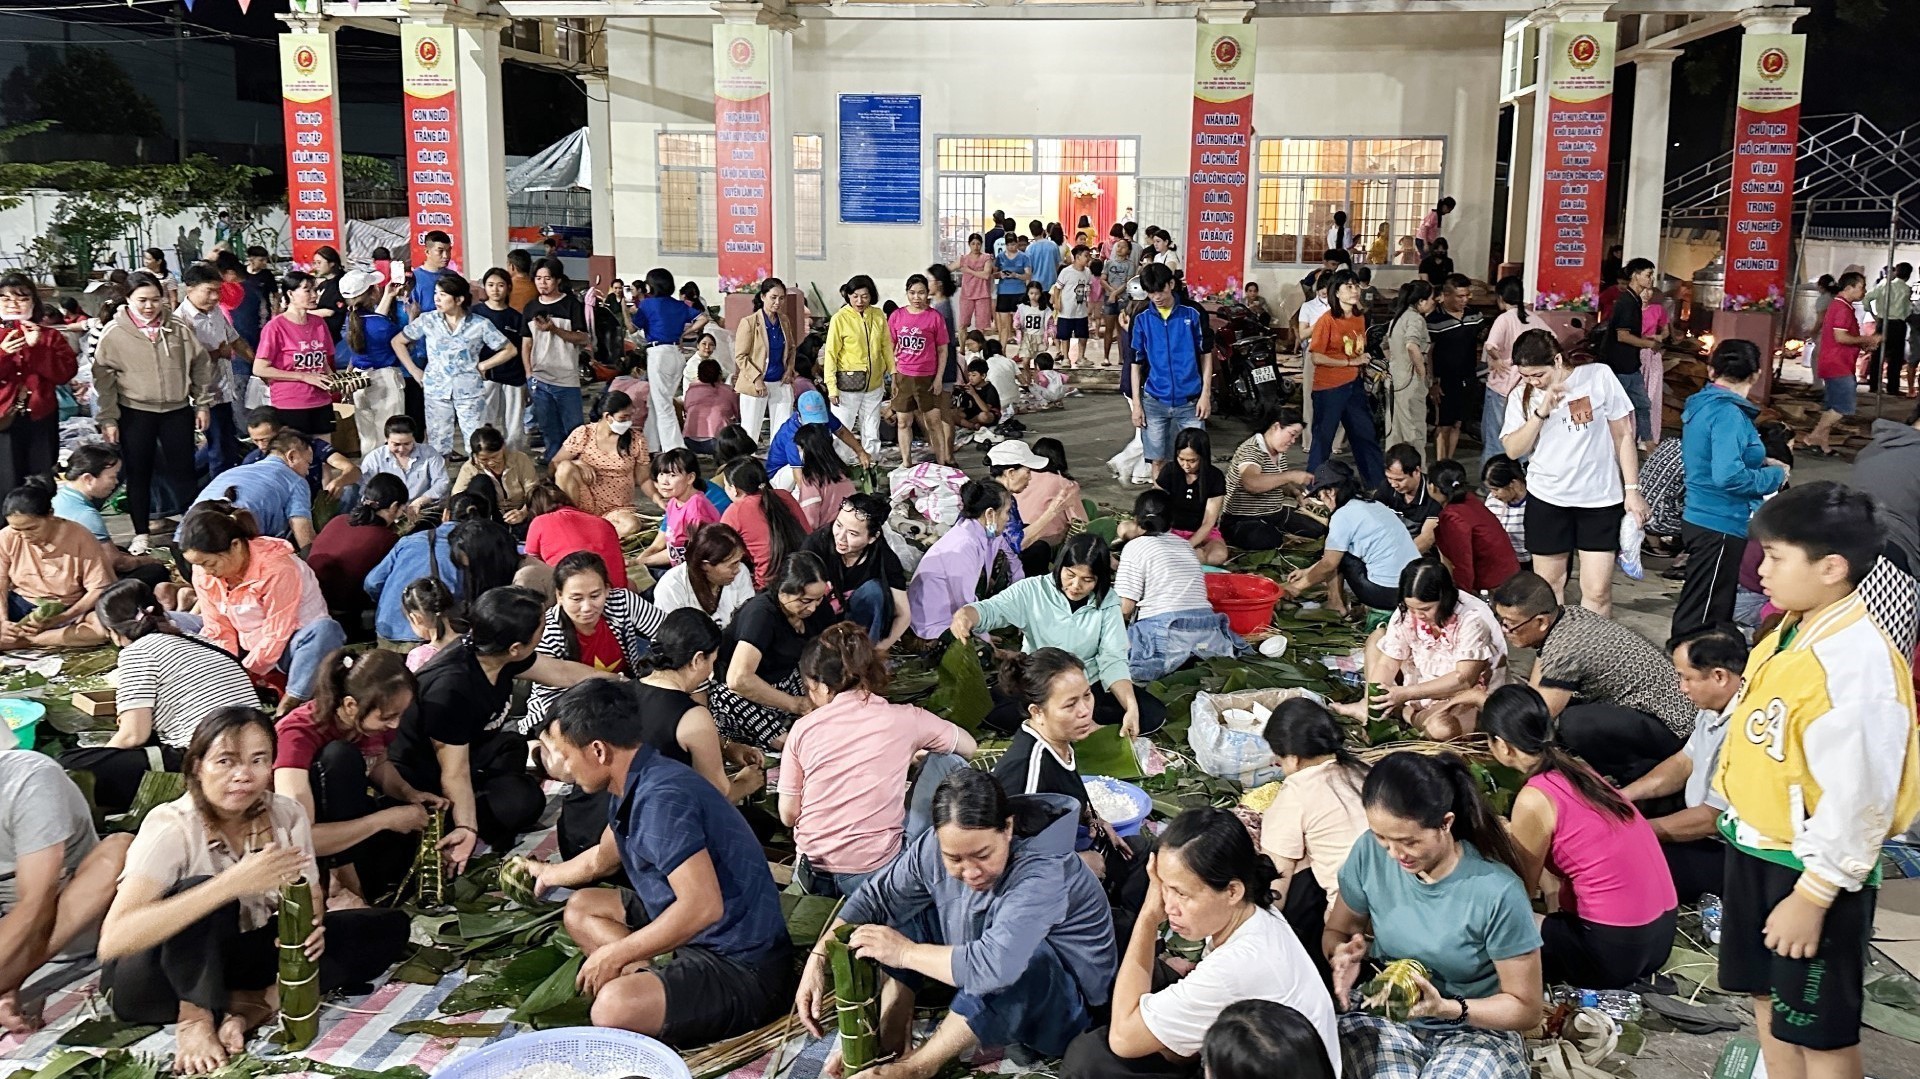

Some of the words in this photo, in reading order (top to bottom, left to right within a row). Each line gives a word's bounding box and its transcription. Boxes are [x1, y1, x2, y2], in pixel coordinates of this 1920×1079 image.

[1205, 112, 1224, 125] NHÂN
[1225, 113, 1239, 126] DÂN
[1748, 121, 1766, 135] CHỦ
[1768, 124, 1787, 137] TỊCH
[1197, 132, 1205, 145] LÀ
[1207, 134, 1228, 145] TRUNG
[1739, 140, 1752, 154] HỒ
[1753, 141, 1769, 154] CHÍ
[1769, 144, 1793, 155] MINH
[1201, 152, 1210, 165] LÀ
[1211, 151, 1225, 165] CHỦ
[1226, 150, 1240, 165] THỂ
[1193, 170, 1207, 183] CỦA
[1208, 171, 1226, 183] CÔNG
[1227, 172, 1245, 187] CUỘC
[1742, 179, 1765, 193] SỐNG
[1767, 180, 1784, 194] MÃI
[1747, 201, 1775, 213] TRONG
[1201, 210, 1215, 222] XÂY
[1215, 211, 1234, 224] DỰNG
[1737, 220, 1750, 234] SỰ
[1751, 219, 1782, 234] NGHIỆP
[1200, 228, 1209, 241] VÀ
[1210, 228, 1223, 241] BẢO
[1224, 229, 1233, 244] VỆ
[1749, 237, 1767, 251] CỦA
[1735, 257, 1764, 270] CHÚNG
[1026, 315, 1041, 329] 88
[1562, 411, 1590, 425] HAVE
[1568, 422, 1588, 432] FUN
